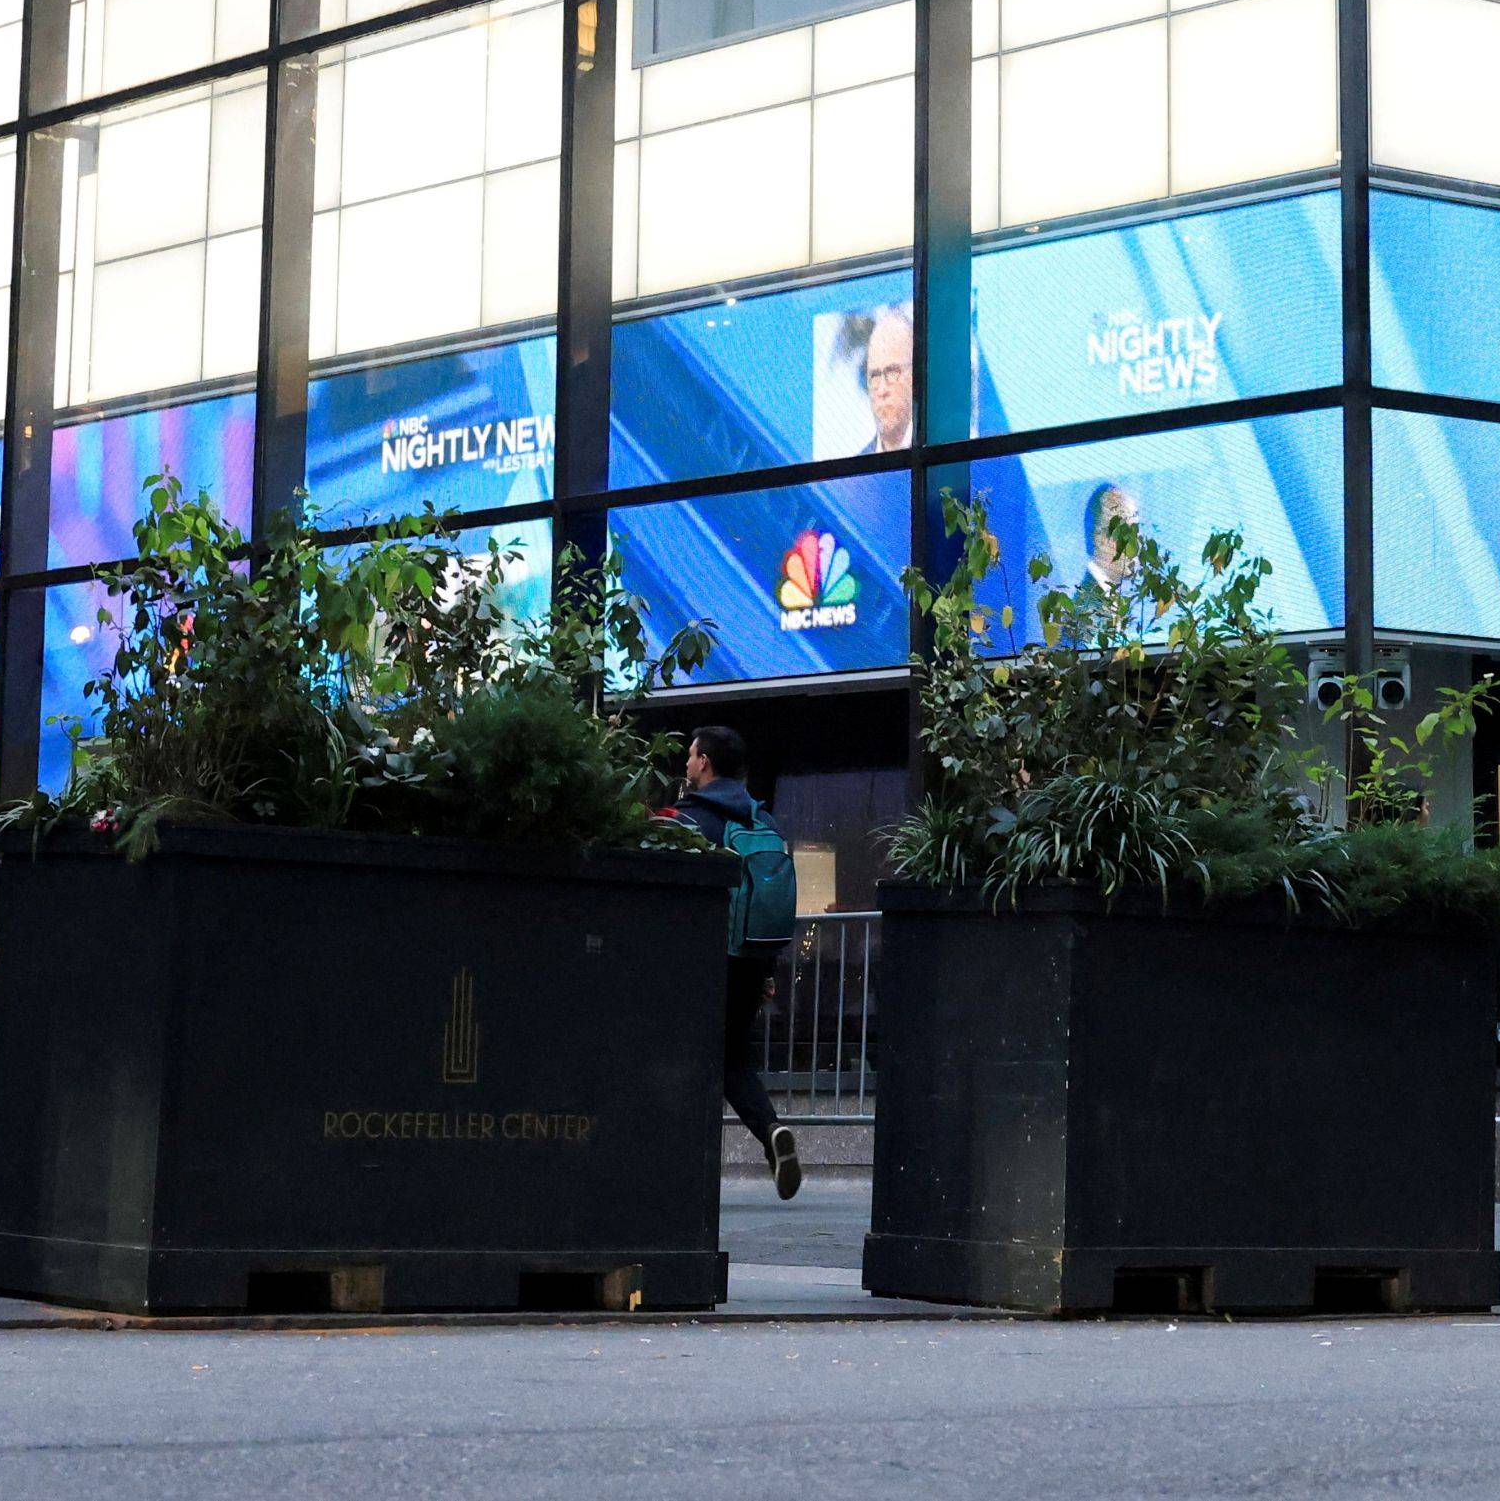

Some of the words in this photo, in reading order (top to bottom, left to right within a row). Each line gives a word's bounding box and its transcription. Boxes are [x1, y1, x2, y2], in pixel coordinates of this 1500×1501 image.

[1087, 312, 1222, 366] NIGHTLY
[1118, 348, 1219, 395] NEWS
[382, 424, 492, 474] NIGHTLY
[496, 414, 556, 457] NEW
[400, 415, 429, 436] NBC
[780, 608, 811, 631] NBC
[812, 603, 857, 628] NEWS
[323, 1111, 494, 1139] ROCKEFELLER
[502, 1113, 591, 1140] CENTER
